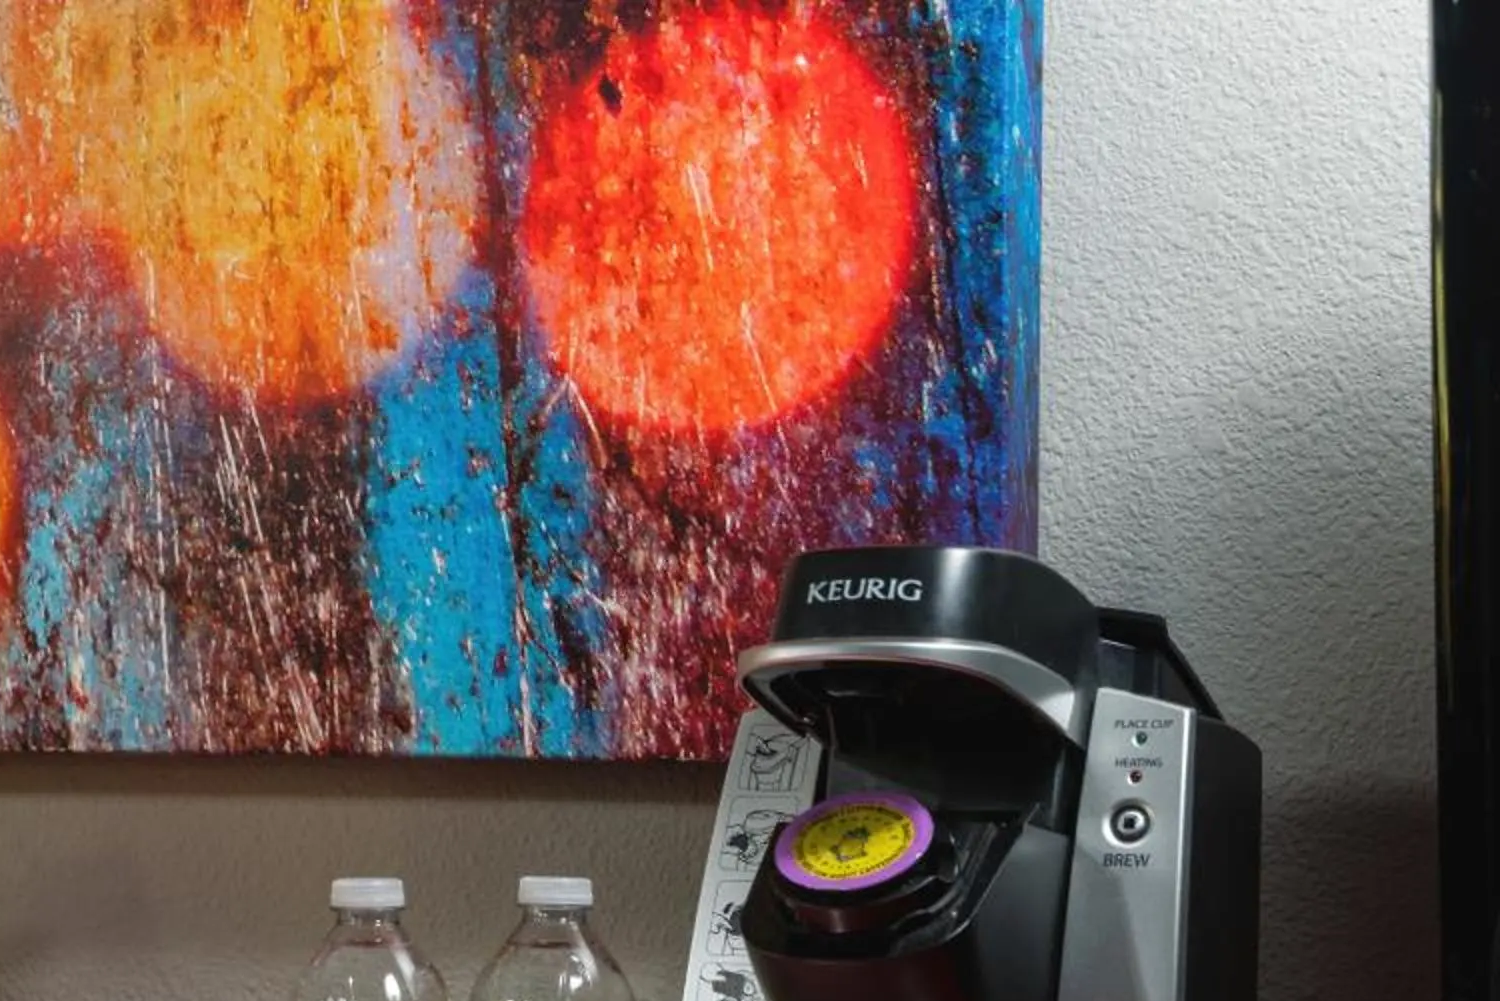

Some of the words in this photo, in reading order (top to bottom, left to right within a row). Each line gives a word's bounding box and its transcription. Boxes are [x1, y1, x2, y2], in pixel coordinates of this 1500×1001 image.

[807, 577, 924, 605] KEURIG
[1114, 718, 1149, 730] PLACE
[1150, 718, 1175, 729] CUP
[1114, 757, 1164, 769] HEATING
[1103, 853, 1151, 869] BREW
